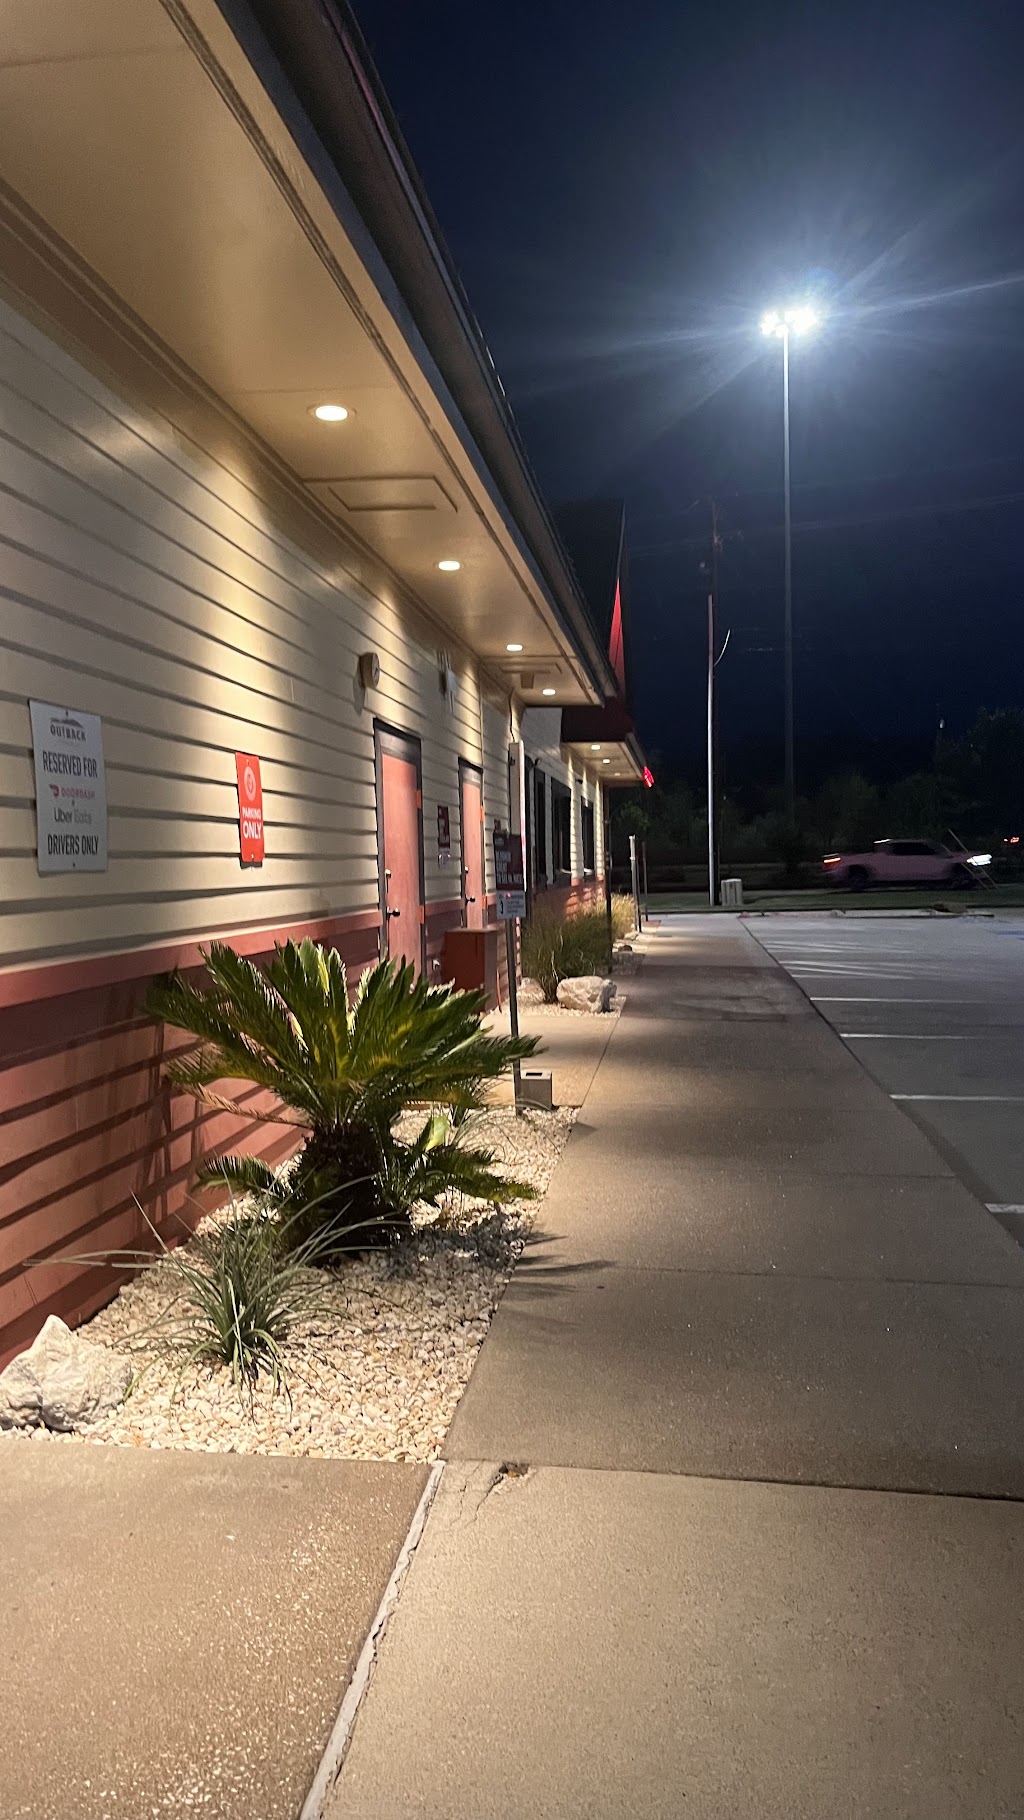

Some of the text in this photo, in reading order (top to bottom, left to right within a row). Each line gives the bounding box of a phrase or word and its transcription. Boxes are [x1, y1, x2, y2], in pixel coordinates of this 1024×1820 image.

[50, 723, 86, 742] OUTBACK
[42, 750, 98, 778] RESERVED FOR
[61, 788, 95, 801] DOORDASH
[54, 807, 92, 825] Uber Eats
[242, 806, 261, 820] PARKING
[243, 820, 262, 840] ONLY
[47, 834, 99, 856] DRIVERS ONLY
